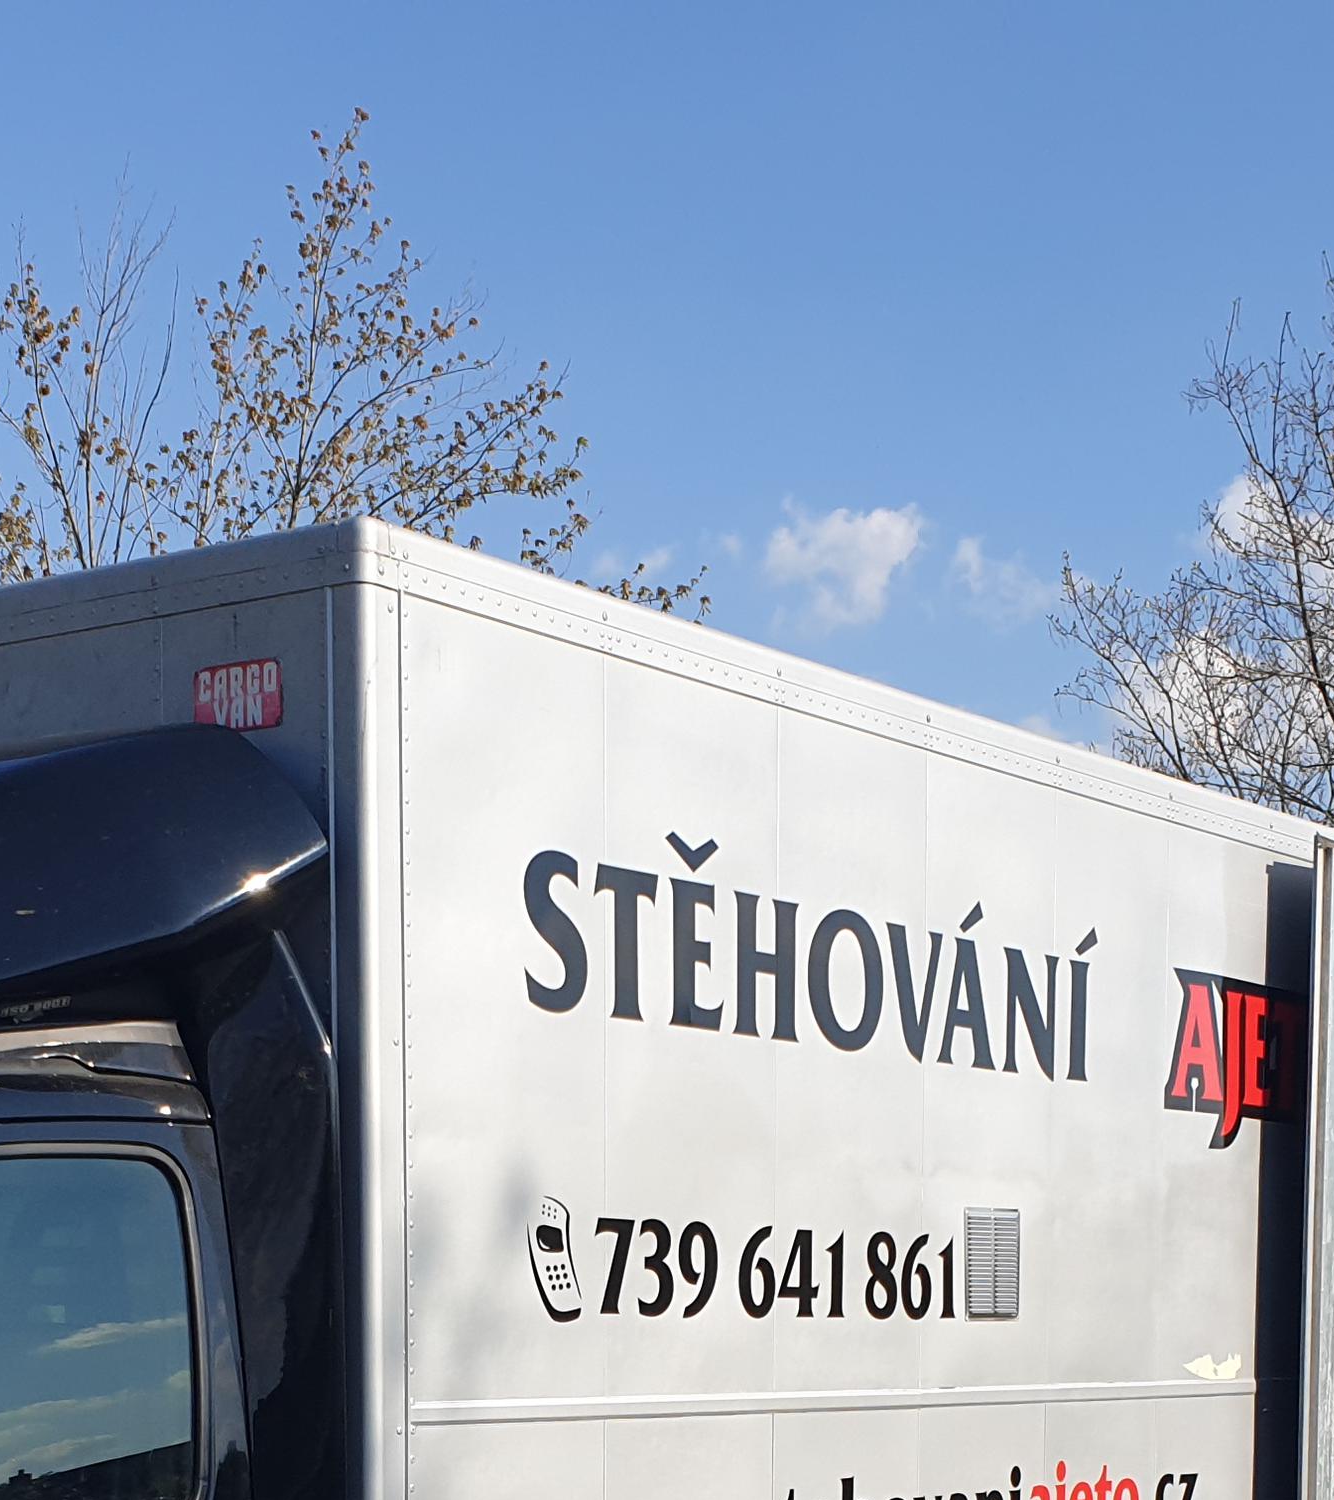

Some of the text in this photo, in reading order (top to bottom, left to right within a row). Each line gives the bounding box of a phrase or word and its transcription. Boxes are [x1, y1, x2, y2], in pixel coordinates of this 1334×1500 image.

[199, 662, 276, 704] CARGO
[214, 694, 262, 728] VAN
[524, 831, 1098, 1082] STĚHOVÁNÍ
[594, 1217, 955, 1320] 739 641 861
